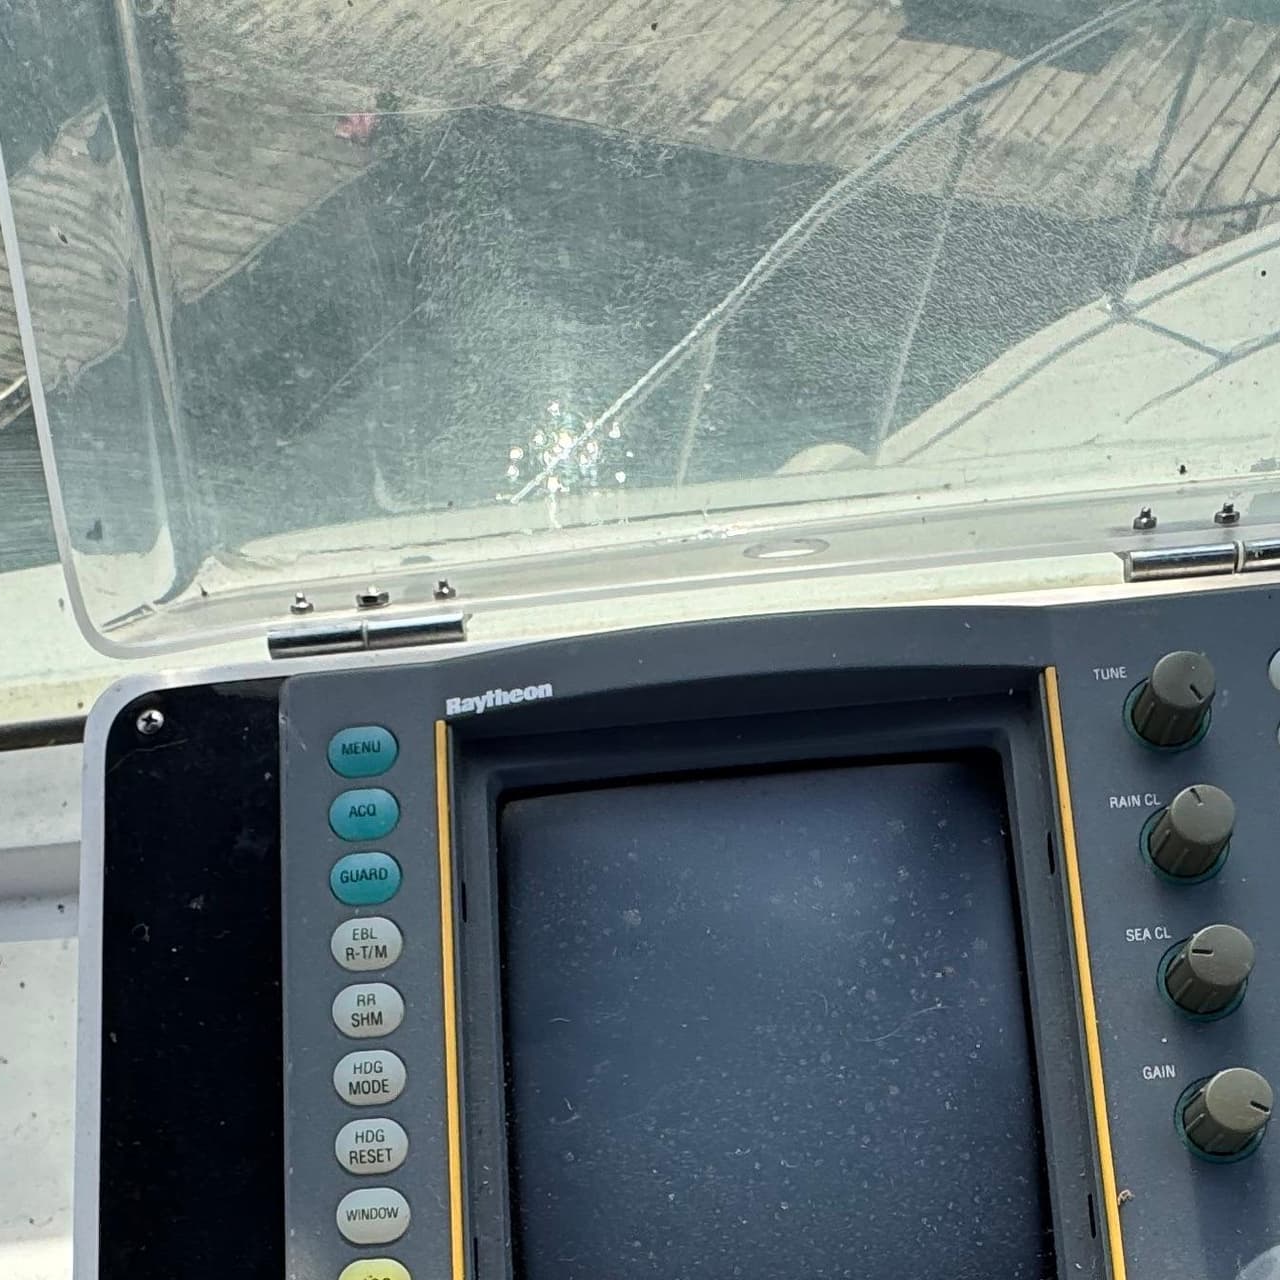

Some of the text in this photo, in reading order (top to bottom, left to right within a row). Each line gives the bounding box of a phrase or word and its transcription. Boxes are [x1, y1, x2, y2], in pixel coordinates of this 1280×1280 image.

[1093, 667, 1128, 681] TUNE
[446, 683, 553, 716] Raytheon
[341, 740, 381, 755] MENU
[1109, 793, 1161, 809] RAIN CL
[348, 804, 376, 818] ACQ
[340, 868, 388, 883] GUARD
[352, 928, 378, 941] EBL
[1126, 926, 1171, 942] SEA CL
[345, 945, 388, 961] R-T/M
[357, 994, 376, 1006] RR
[351, 1011, 383, 1028] SHM
[353, 1061, 383, 1074] HDG
[1143, 1065, 1175, 1080] GAIN
[348, 1079, 389, 1095] MODE
[355, 1129, 385, 1143] HDG
[349, 1148, 392, 1165] RESET
[346, 1207, 399, 1222] WINDOW
